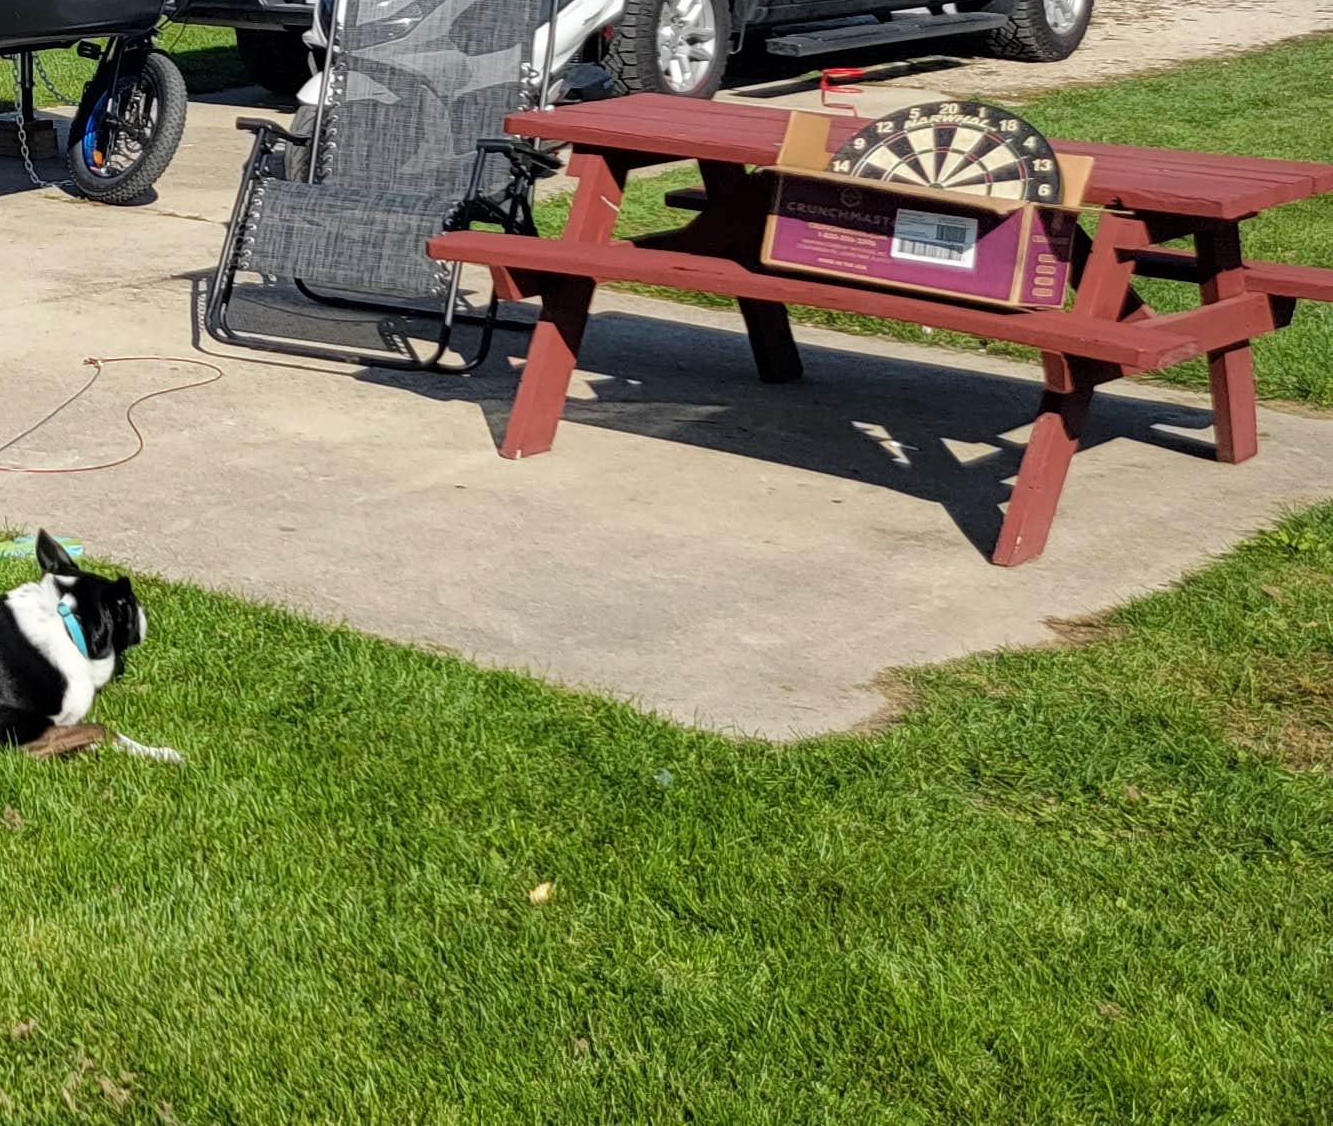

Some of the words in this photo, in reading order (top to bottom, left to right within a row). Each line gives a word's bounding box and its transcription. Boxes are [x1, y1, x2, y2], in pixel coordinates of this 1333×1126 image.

[909, 108, 920, 120] 5
[939, 103, 958, 115] 20
[978, 107, 986, 117] 1
[876, 121, 894, 133] 12
[904, 114, 992, 130] NARWHAL
[999, 120, 1018, 131] 18
[853, 138, 866, 150] 9
[1023, 136, 1036, 148] 4
[832, 160, 849, 173] 14
[1033, 159, 1052, 171] 13
[1037, 184, 1050, 196] 6
[787, 202, 894, 226] CRUNCHMAST
